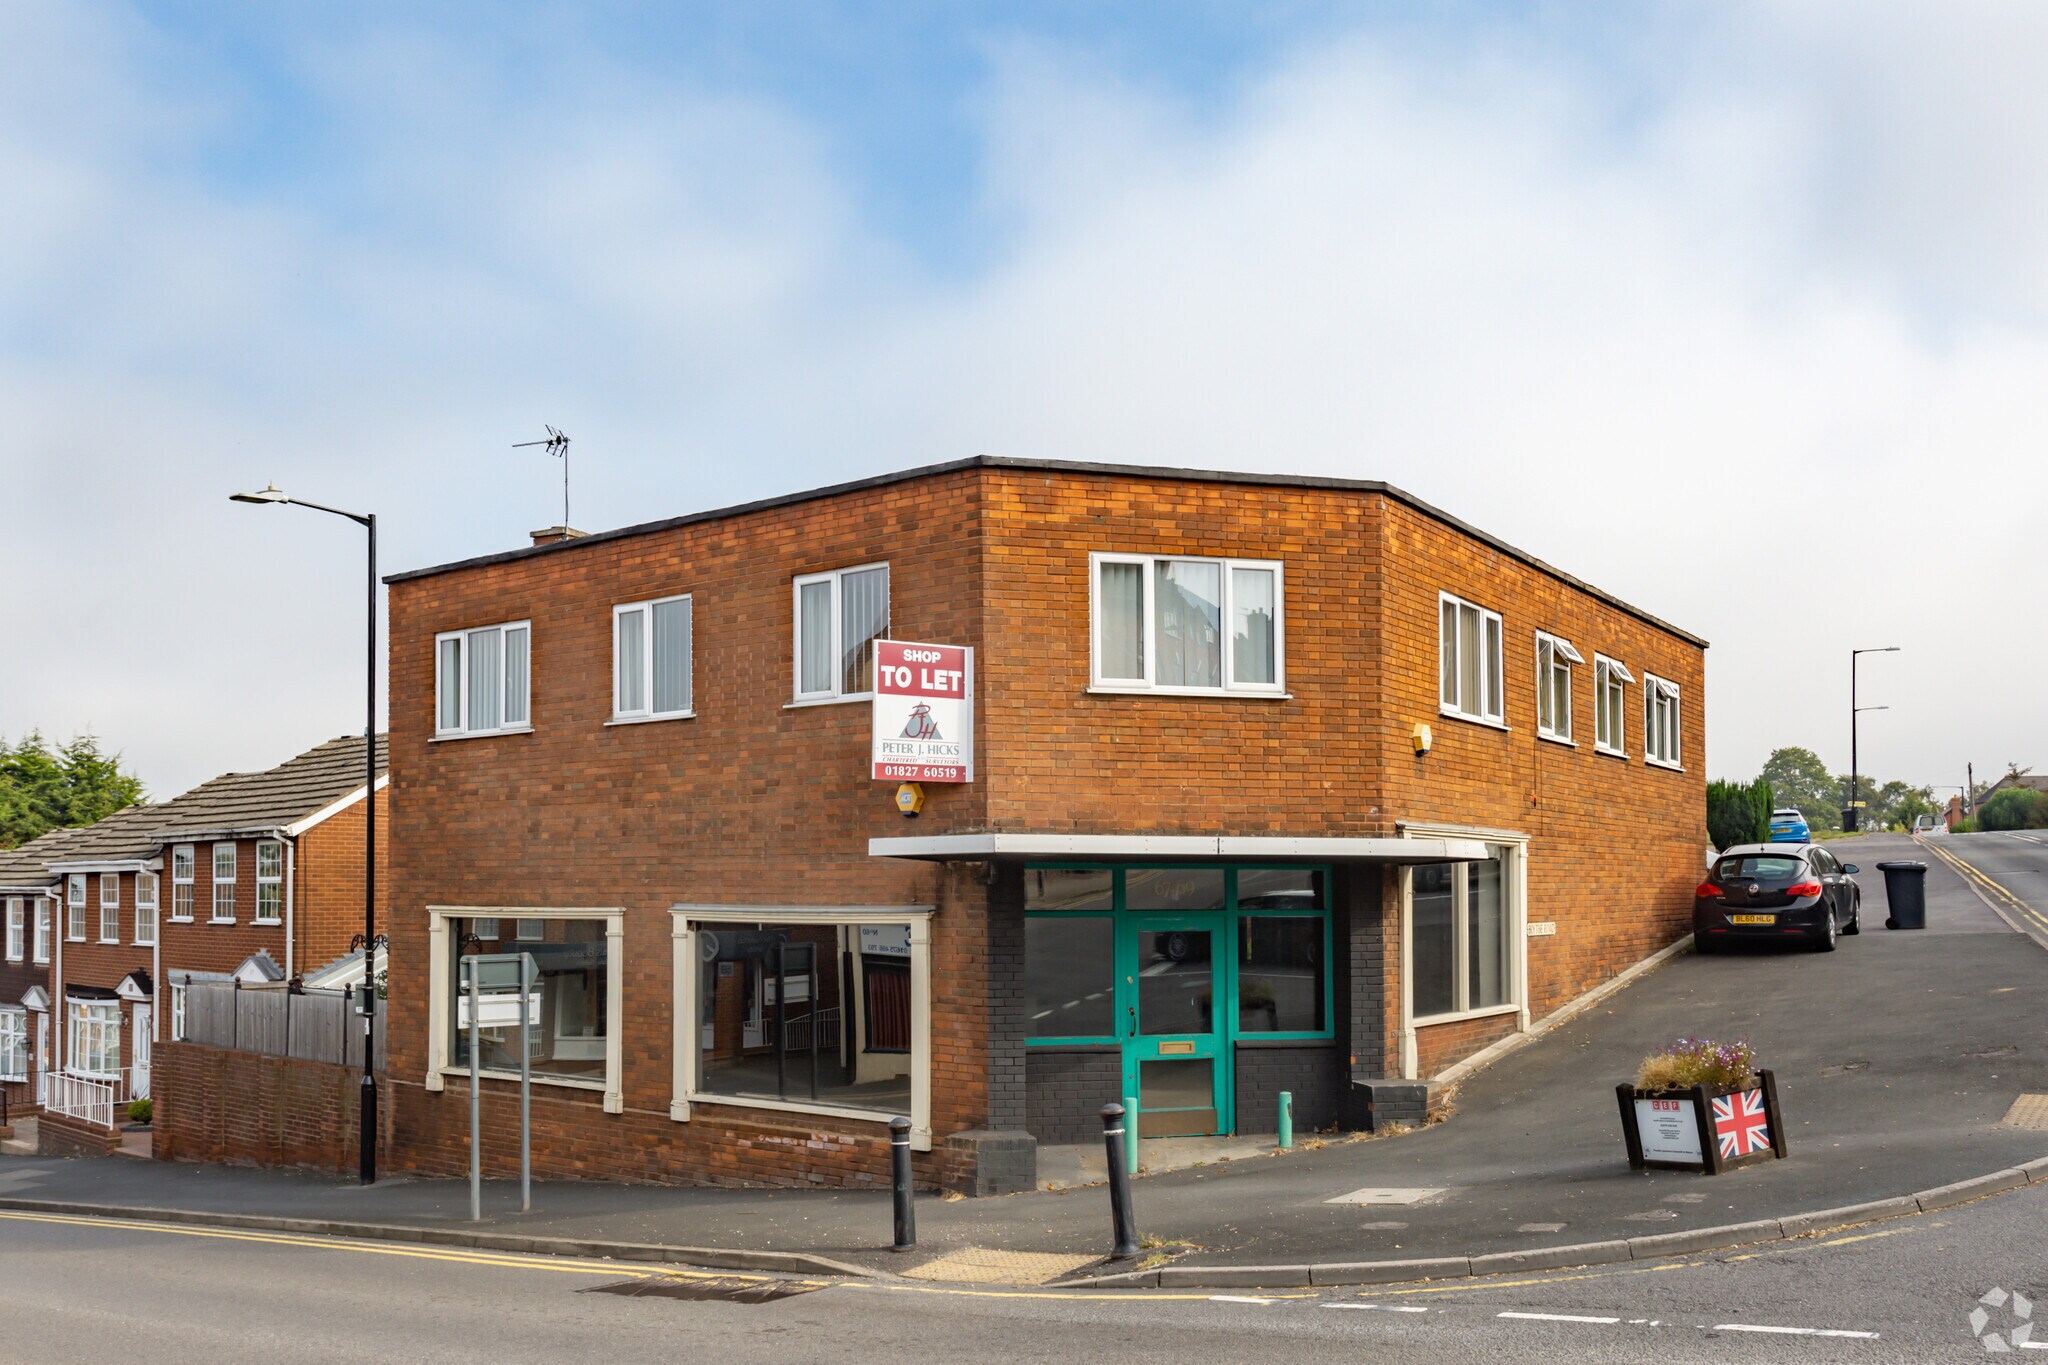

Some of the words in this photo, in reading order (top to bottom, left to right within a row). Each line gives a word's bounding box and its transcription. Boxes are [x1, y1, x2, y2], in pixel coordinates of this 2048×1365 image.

[903, 649, 941, 663] SHOP
[881, 665, 912, 688] TO
[921, 669, 962, 691] LET
[882, 742, 914, 754] PETER
[918, 744, 924, 756] J.
[927, 745, 959, 756] HICKS
[885, 765, 918, 777] 01827
[924, 767, 957, 778] 60519
[1652, 1101, 1679, 1111] CEF
